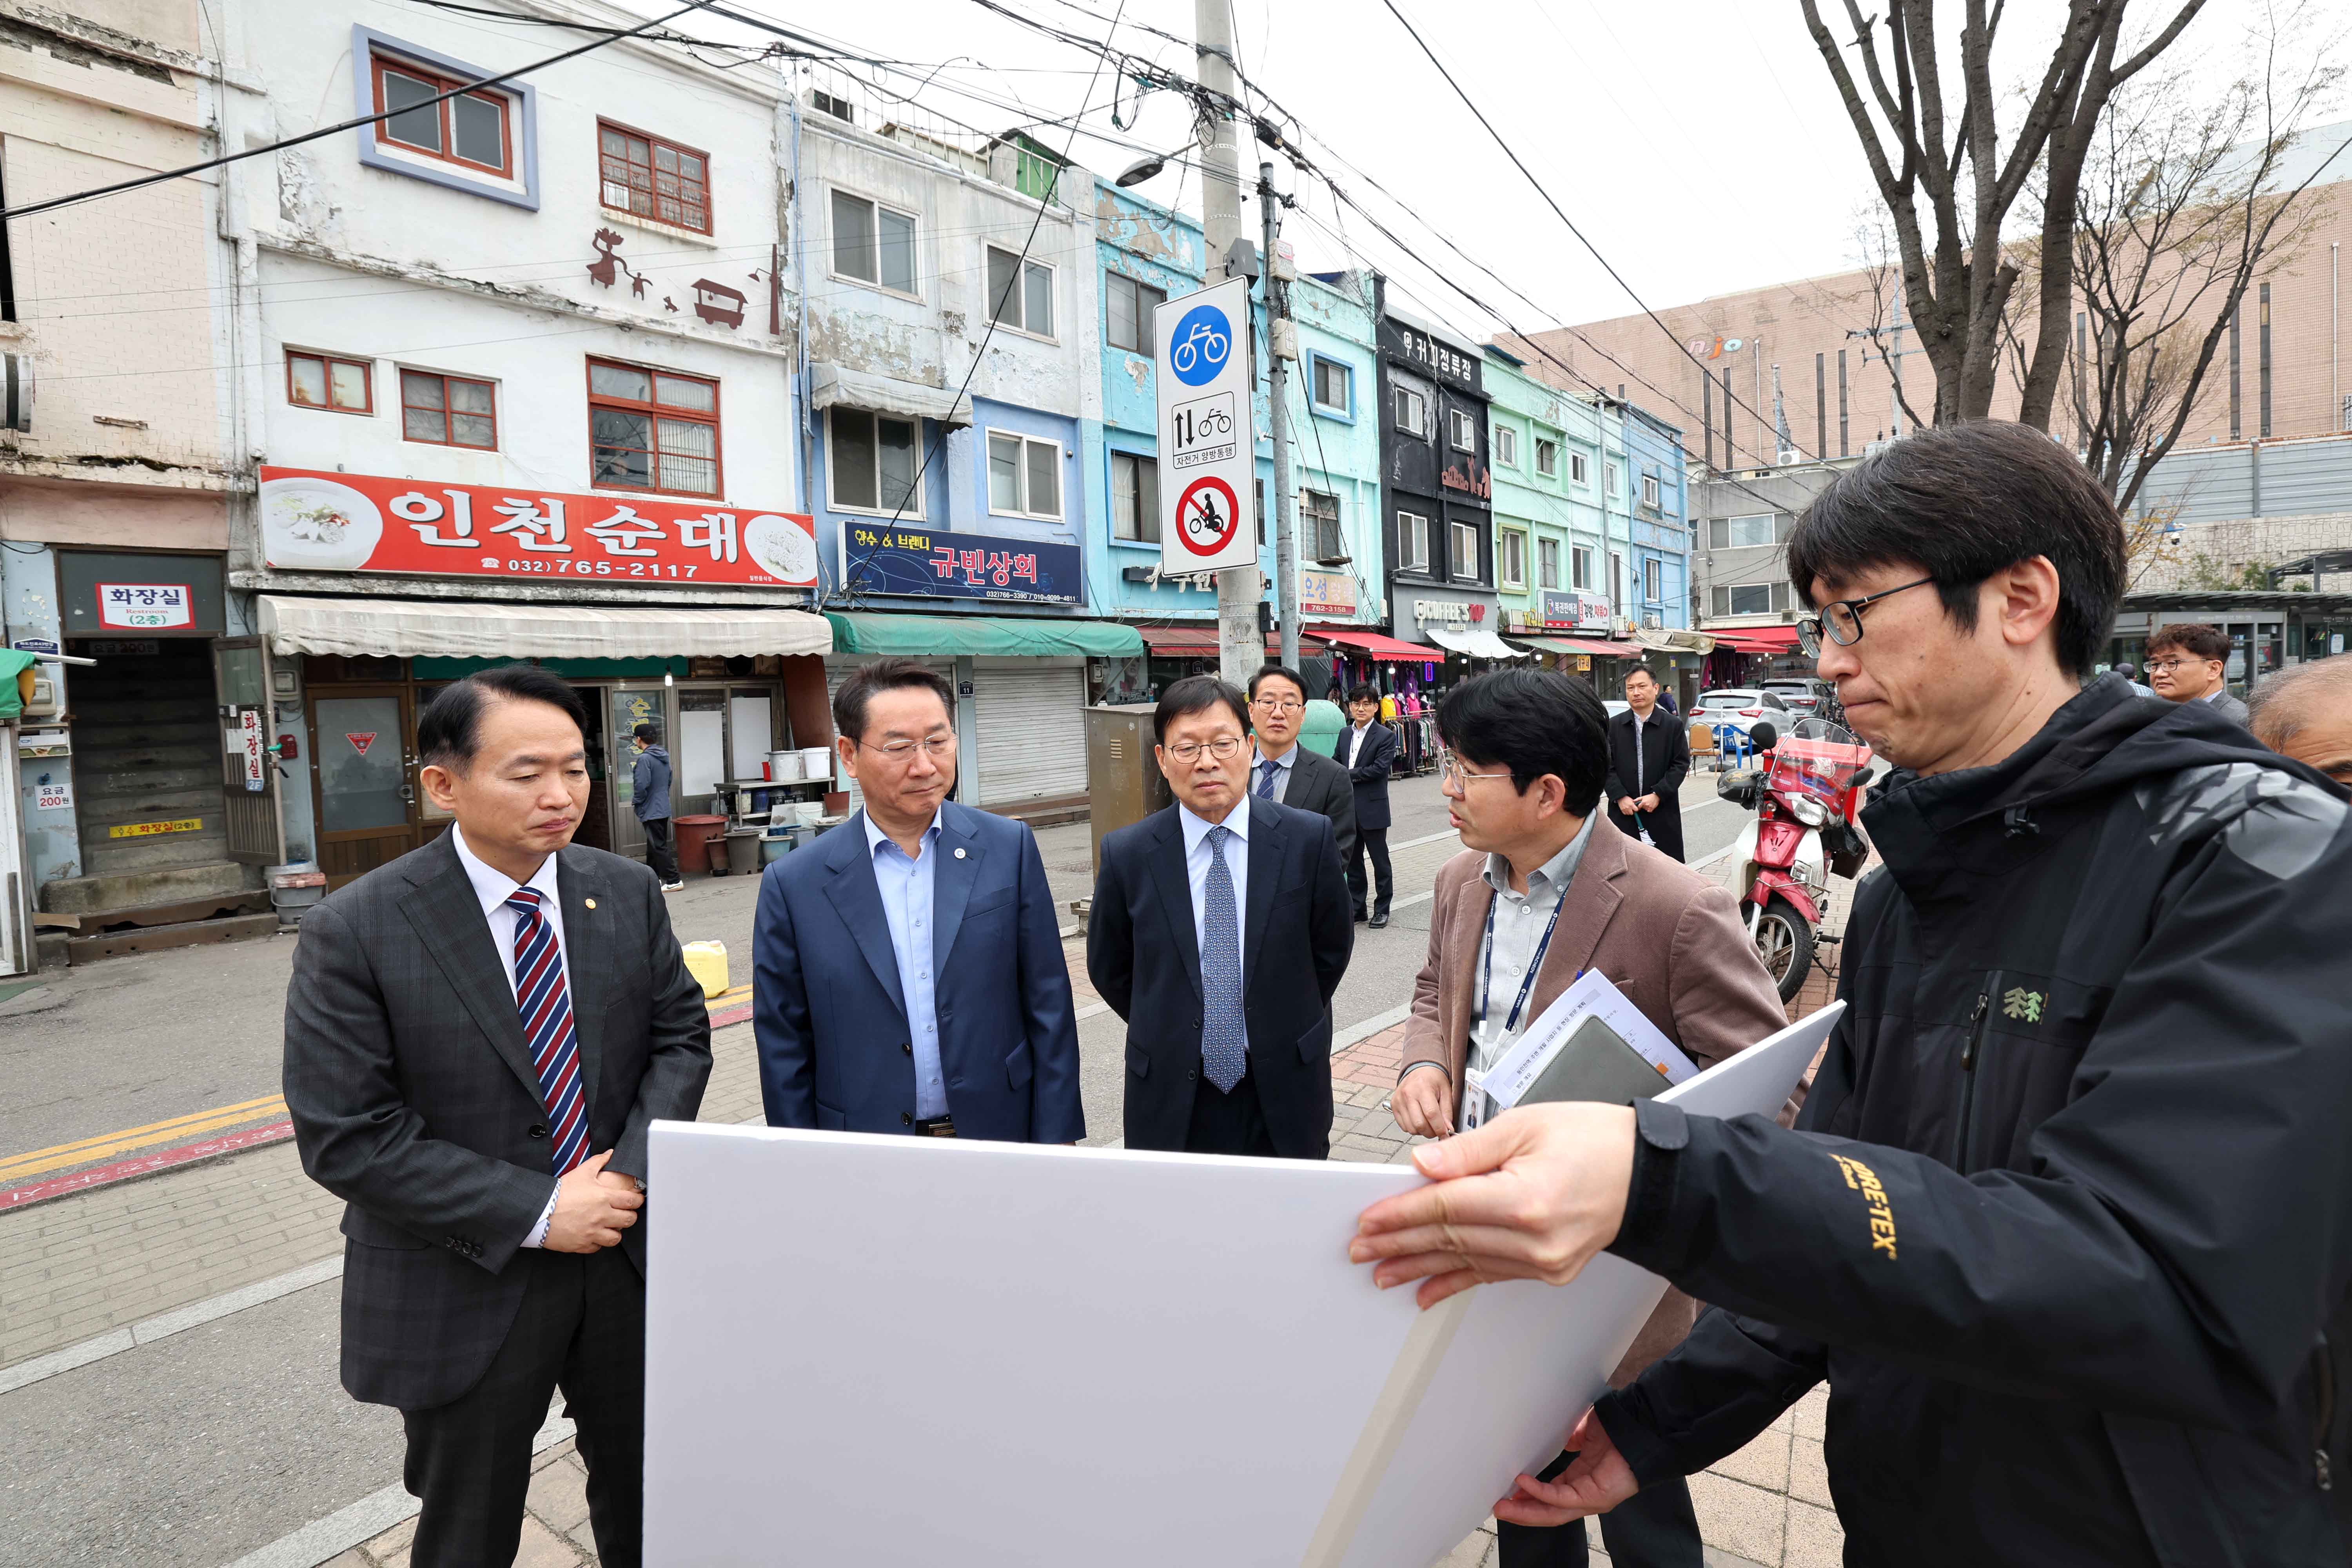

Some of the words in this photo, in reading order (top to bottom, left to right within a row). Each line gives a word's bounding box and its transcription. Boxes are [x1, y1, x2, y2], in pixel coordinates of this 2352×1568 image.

[1177, 453, 1199, 465] 자전거
[1202, 446, 1232, 461] 양방통행
[389, 489, 738, 563] 인천순대
[855, 530, 878, 546] 향수
[883, 534, 893, 547] &
[898, 534, 929, 551] 브랜디
[929, 547, 1036, 586] 규빈상회
[110, 589, 181, 605] 화장실
[986, 591, 1027, 599] 032)766-3390
[1555, 601, 1577, 614] 복권판매점
[129, 615, 166, 625] (2층)
[244, 712, 260, 778] 화장실
[42, 787, 64, 795] 요금
[249, 780, 261, 790] 2F
[40, 797, 69, 806] 200원
